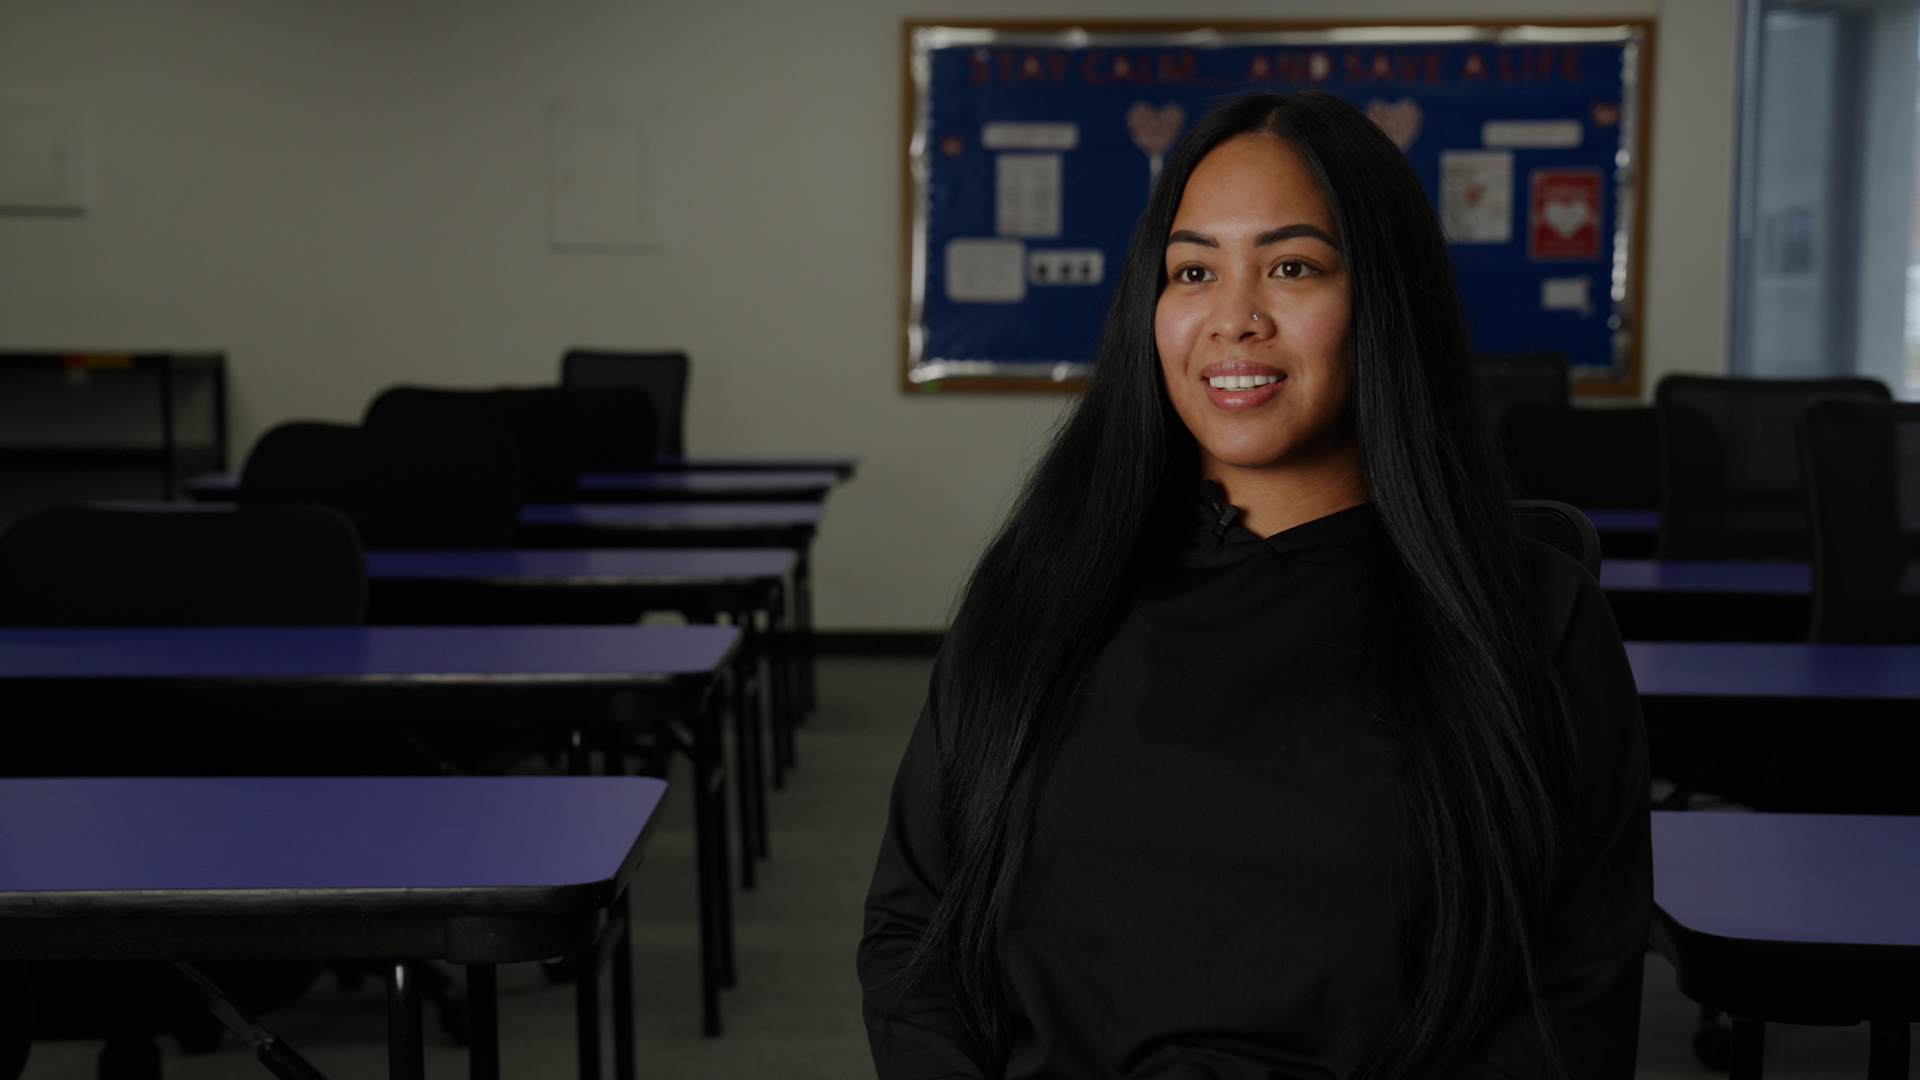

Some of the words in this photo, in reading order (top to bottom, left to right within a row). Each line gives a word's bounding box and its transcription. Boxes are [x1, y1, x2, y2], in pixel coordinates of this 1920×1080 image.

[967, 48, 1071, 86] STAY
[1245, 49, 1331, 84] AND
[1344, 49, 1446, 85] SAVE
[1459, 48, 1490, 84] A
[1497, 46, 1586, 84] LIFE
